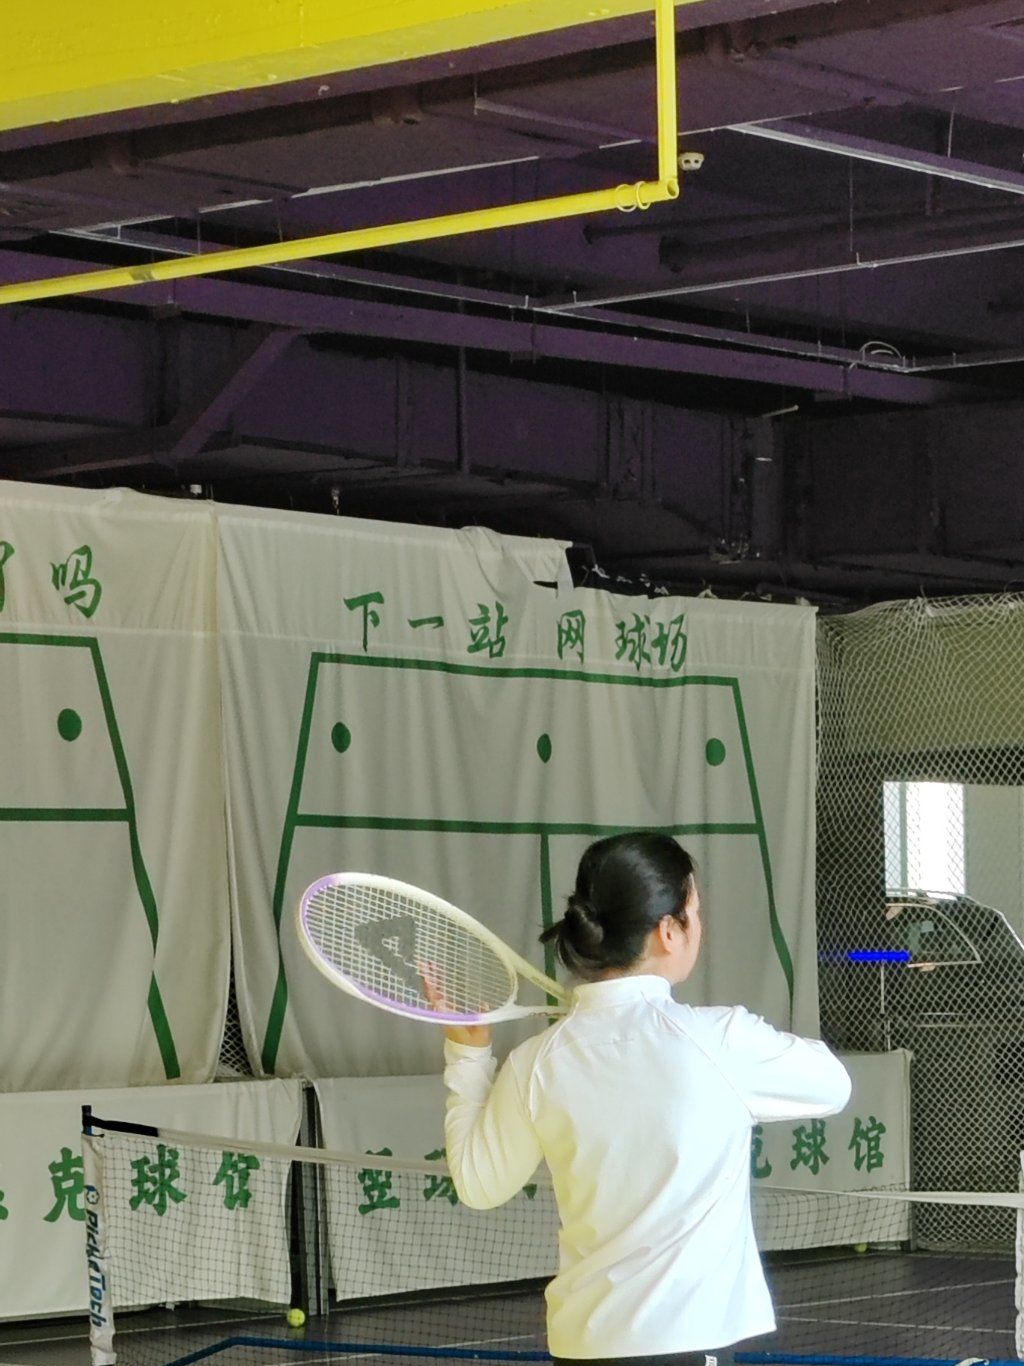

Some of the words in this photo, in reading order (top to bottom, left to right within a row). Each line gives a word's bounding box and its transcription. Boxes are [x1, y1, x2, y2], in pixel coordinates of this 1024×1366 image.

[343, 591, 509, 659] 下一站
[557, 609, 688, 673] 网球场
[0, 1143, 261, 1223] 克球馆
